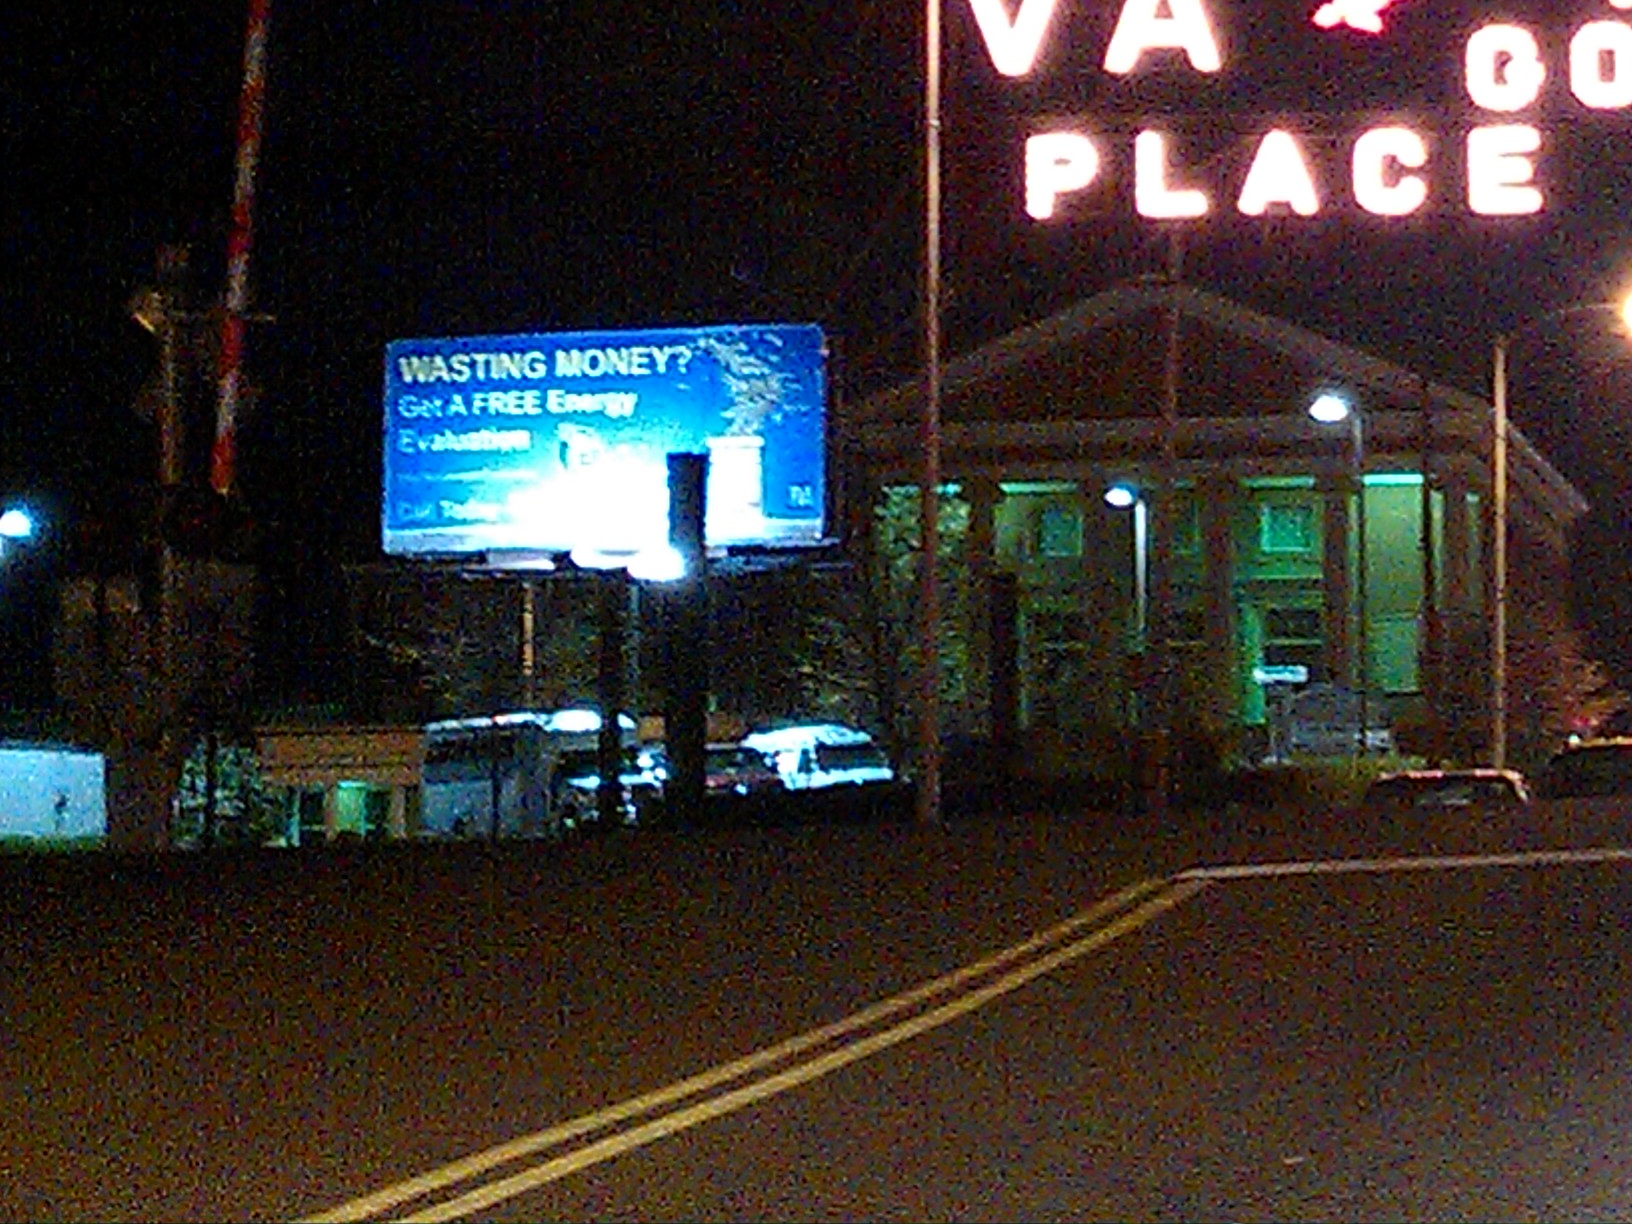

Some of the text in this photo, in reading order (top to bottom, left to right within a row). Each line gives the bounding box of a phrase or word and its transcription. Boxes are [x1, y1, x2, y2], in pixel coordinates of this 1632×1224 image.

[1024, 121, 1544, 220] PLACE
[398, 345, 691, 382] WASTING MONEY?
[445, 393, 468, 416] A
[471, 388, 543, 416] FREE
[545, 389, 638, 419] Energy
